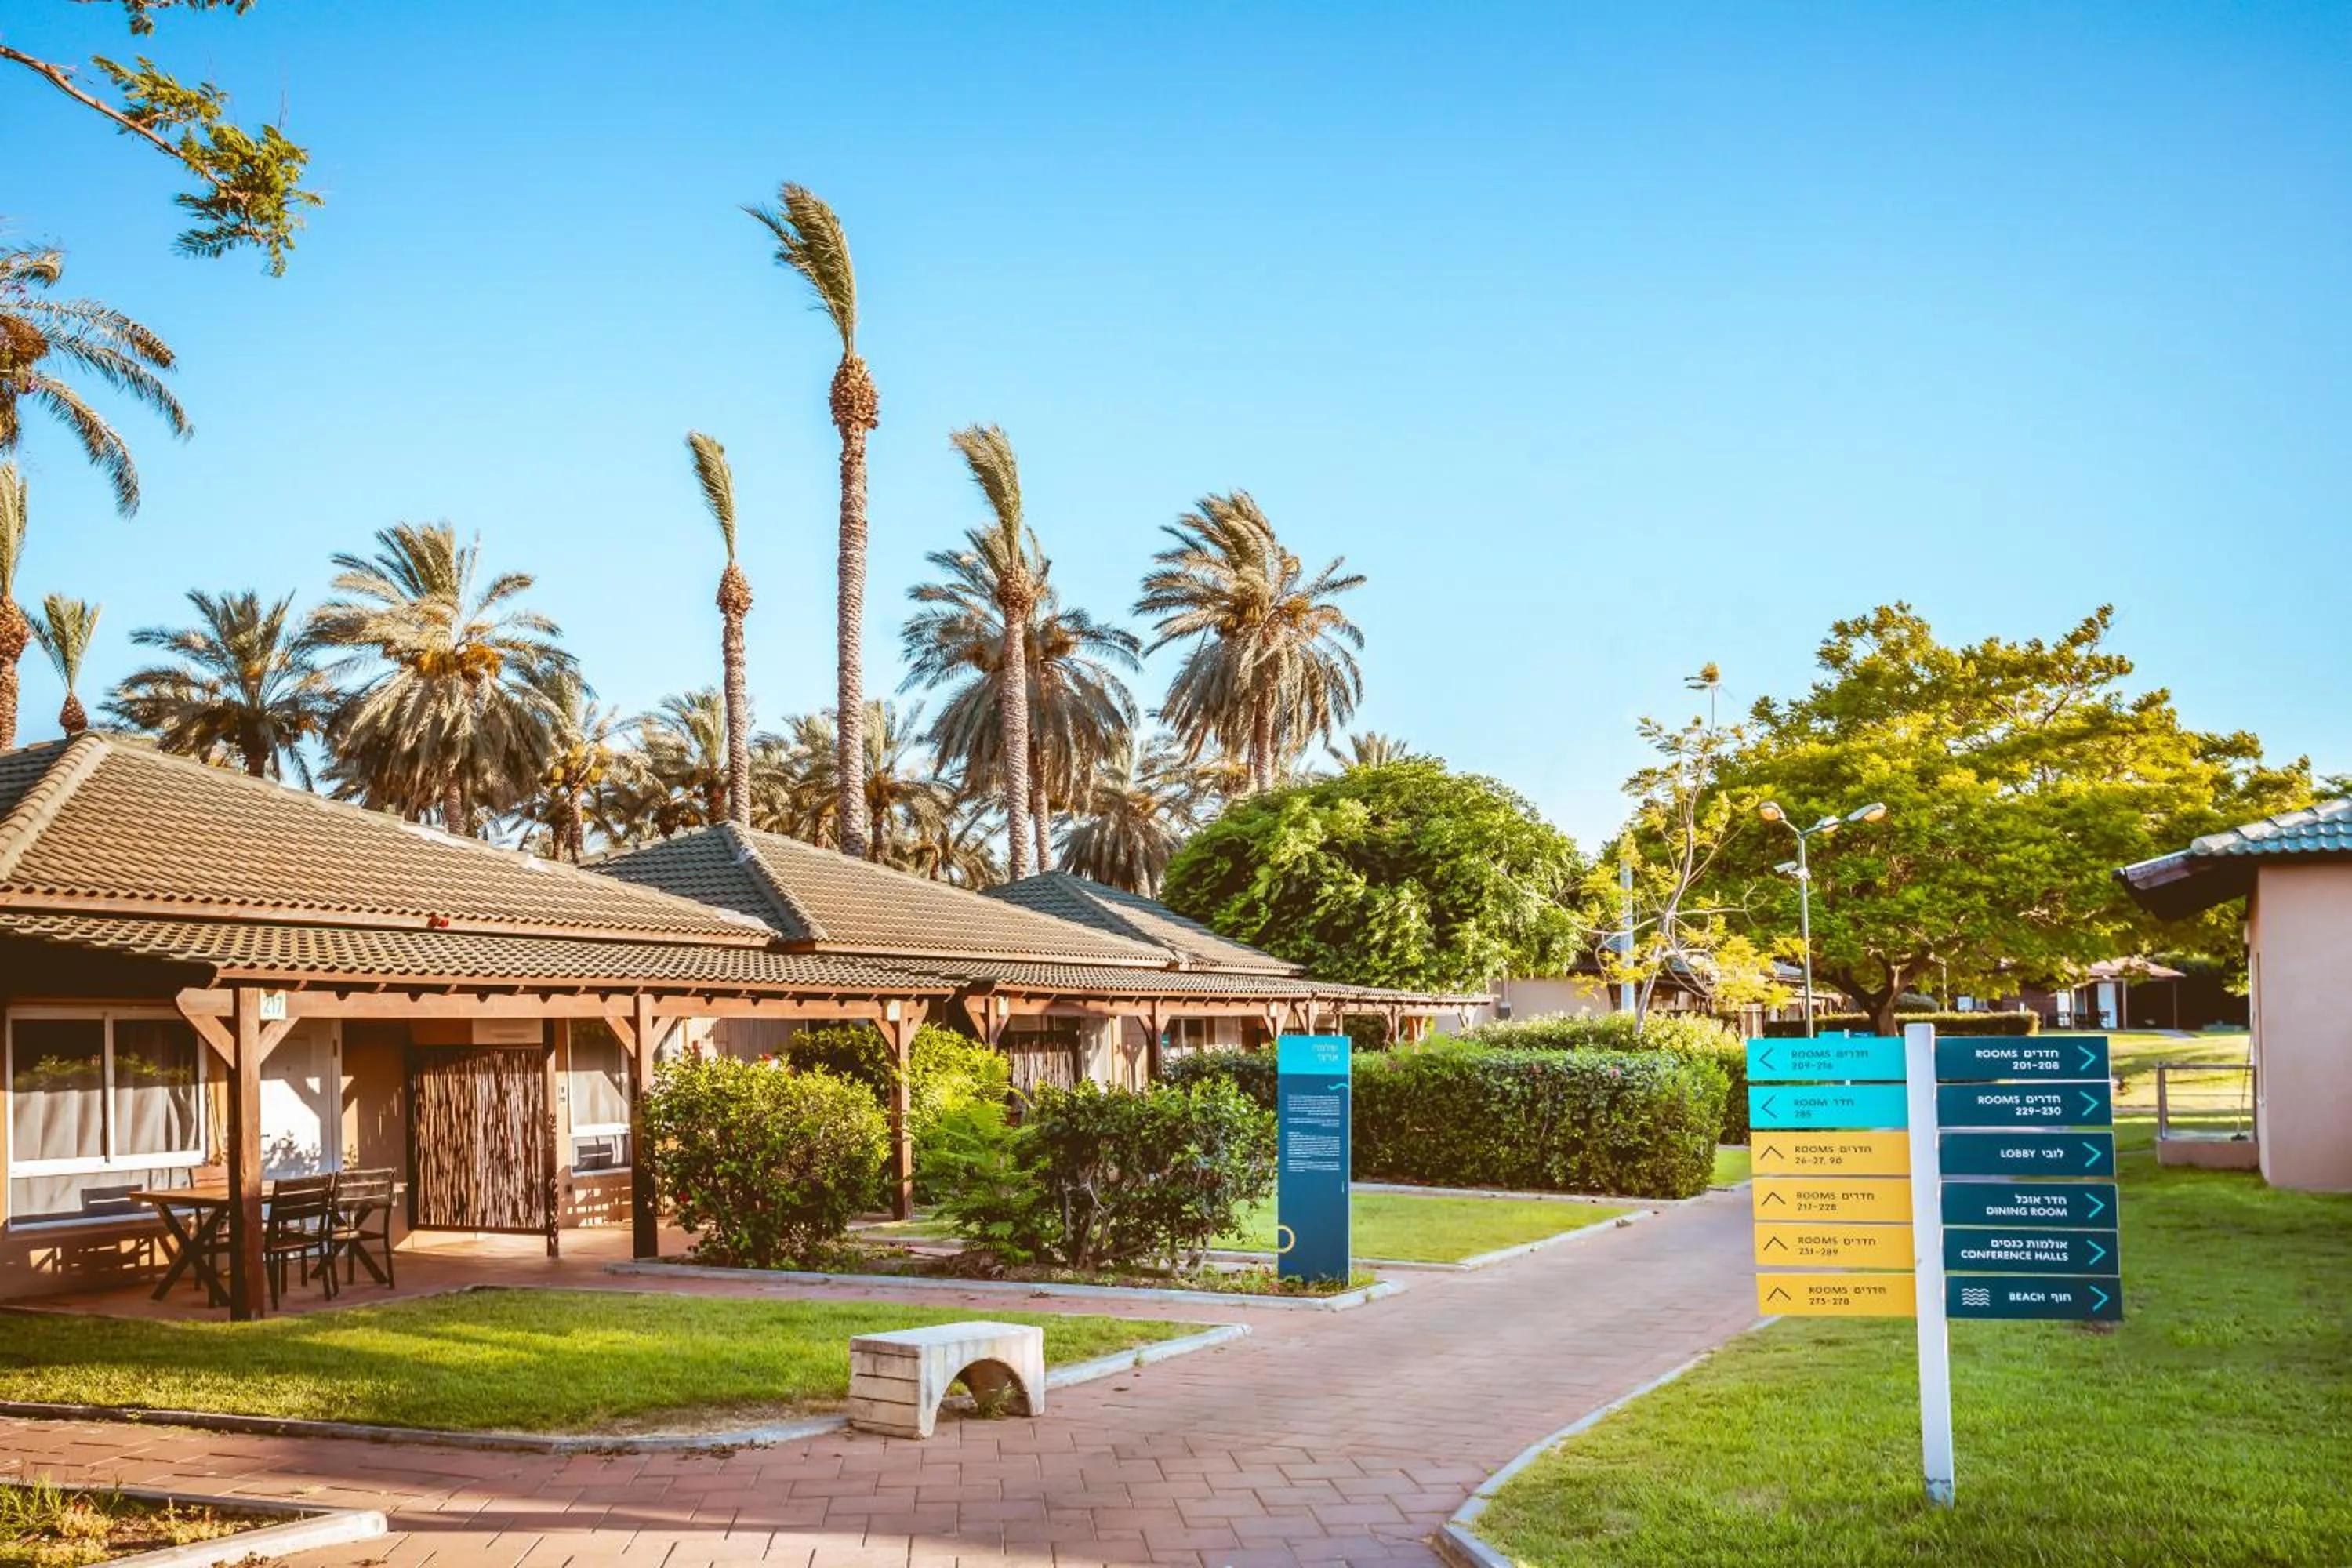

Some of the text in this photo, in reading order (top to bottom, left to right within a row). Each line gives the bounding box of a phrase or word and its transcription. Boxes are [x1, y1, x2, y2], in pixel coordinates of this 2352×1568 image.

[2013, 1061, 2060, 1070] 201-208
[2016, 1107, 2061, 1116] 229-230
[2000, 1149, 2035, 1158] LOBBY
[2042, 1148, 2064, 1158] לובי
[2015, 1193, 2040, 1204] אוכל
[2031, 1208, 2067, 1217] ROOM
[1991, 1239, 2068, 1249] אולמות כנסים
[1961, 1250, 2069, 1261] CONFERENCE HALLS
[2009, 1293, 2046, 1301] BEACH
[2051, 1294, 2071, 1302] חוף
